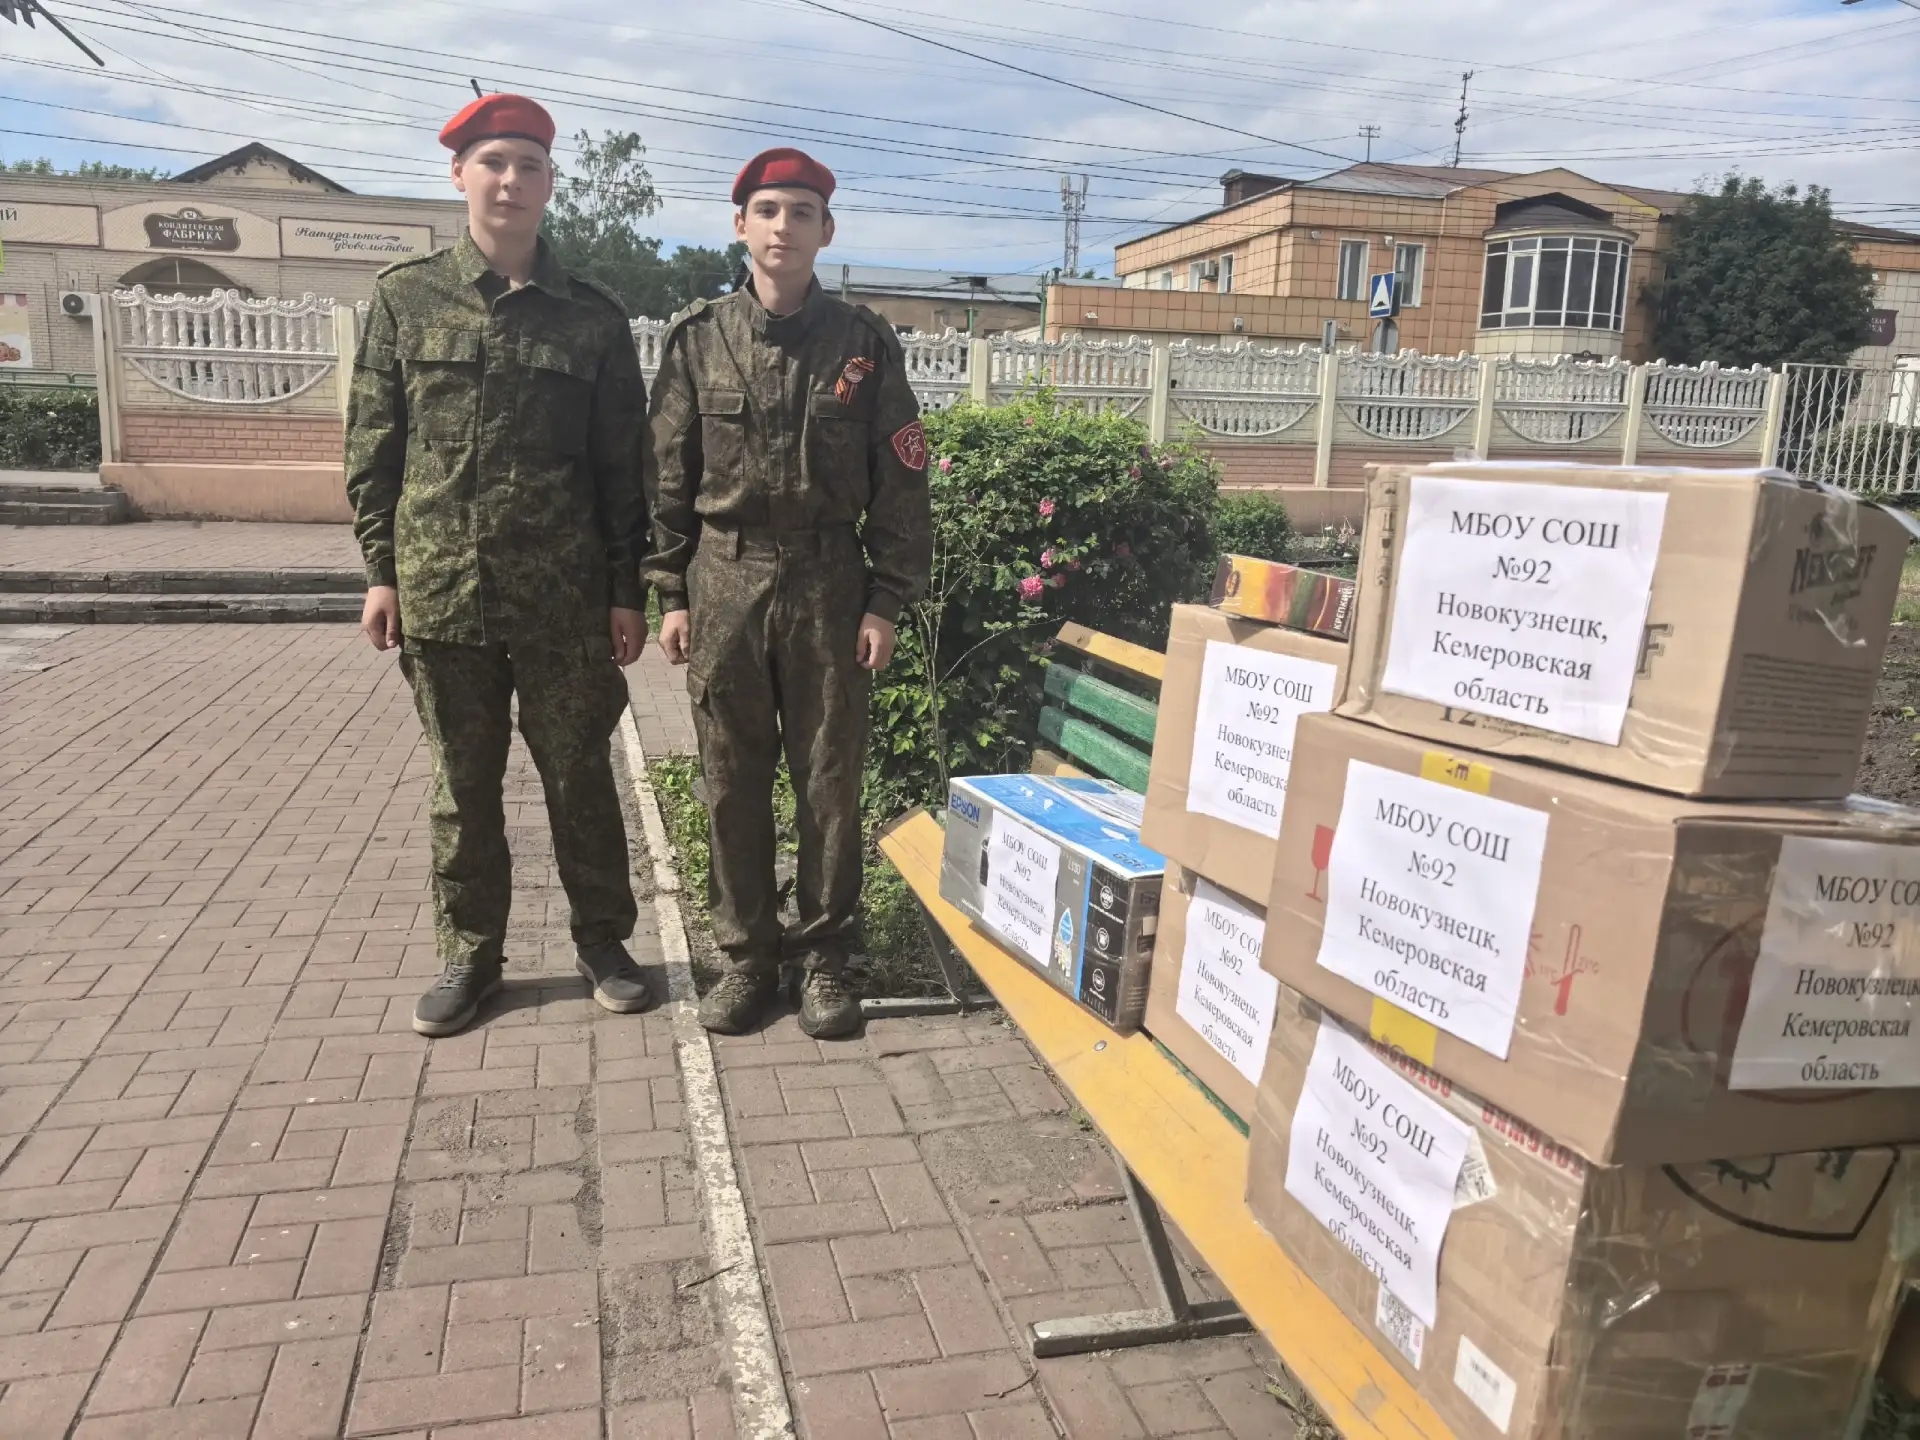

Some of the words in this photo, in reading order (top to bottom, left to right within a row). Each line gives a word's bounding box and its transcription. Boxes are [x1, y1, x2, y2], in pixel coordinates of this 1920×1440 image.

[158, 221, 224, 231] КОНДИТЕРСКАЯ
[162, 229, 222, 240] ФАБРИКА
[295, 227, 400, 241] Натуральное
[334, 240, 415, 252] удовольствие
[1449, 510, 1535, 541] МБОУ
[1542, 518, 1620, 549] СОШ
[1492, 555, 1552, 585] №92
[1436, 591, 1609, 645] Новокузнецк,
[1432, 630, 1593, 681] Кемеровская
[1225, 665, 1270, 692] МБОУ
[1273, 677, 1314, 703] СОШ
[1454, 678, 1550, 716] область
[1246, 700, 1279, 725] №92
[951, 793, 980, 823] EPSON
[1227, 787, 1277, 818] область
[1375, 798, 1442, 838] МБОУ
[1447, 820, 1510, 862] СОШ
[1002, 831, 1026, 855] МБОУ
[1027, 847, 1048, 870] СОШ
[1407, 850, 1457, 887] №92
[1013, 860, 1032, 882] №92
[1816, 874, 1887, 904] МБОУ
[997, 893, 1042, 937] Кемеровская
[1204, 906, 1239, 940] МБОУ
[1360, 876, 1500, 957] Новокузнецк,
[1001, 923, 1029, 951] область
[1357, 914, 1487, 993] Кемеровская
[1847, 921, 1895, 948] №92
[1219, 945, 1244, 976] №92
[1196, 959, 1260, 1027] Новокузнецк,
[1373, 968, 1449, 1020] область
[1193, 983, 1254, 1048] Кемеровская
[1782, 1012, 1911, 1044] Кемеровская
[1201, 1022, 1237, 1063] область
[1801, 1055, 1879, 1082] область
[1332, 1056, 1381, 1110] МБОУ
[1382, 1103, 1436, 1158] СОШ
[1350, 1115, 1388, 1164] №92
[1316, 1127, 1419, 1245] Новокузнецк,
[1313, 1160, 1413, 1271] Кемеровская
[1328, 1217, 1389, 1284] область
